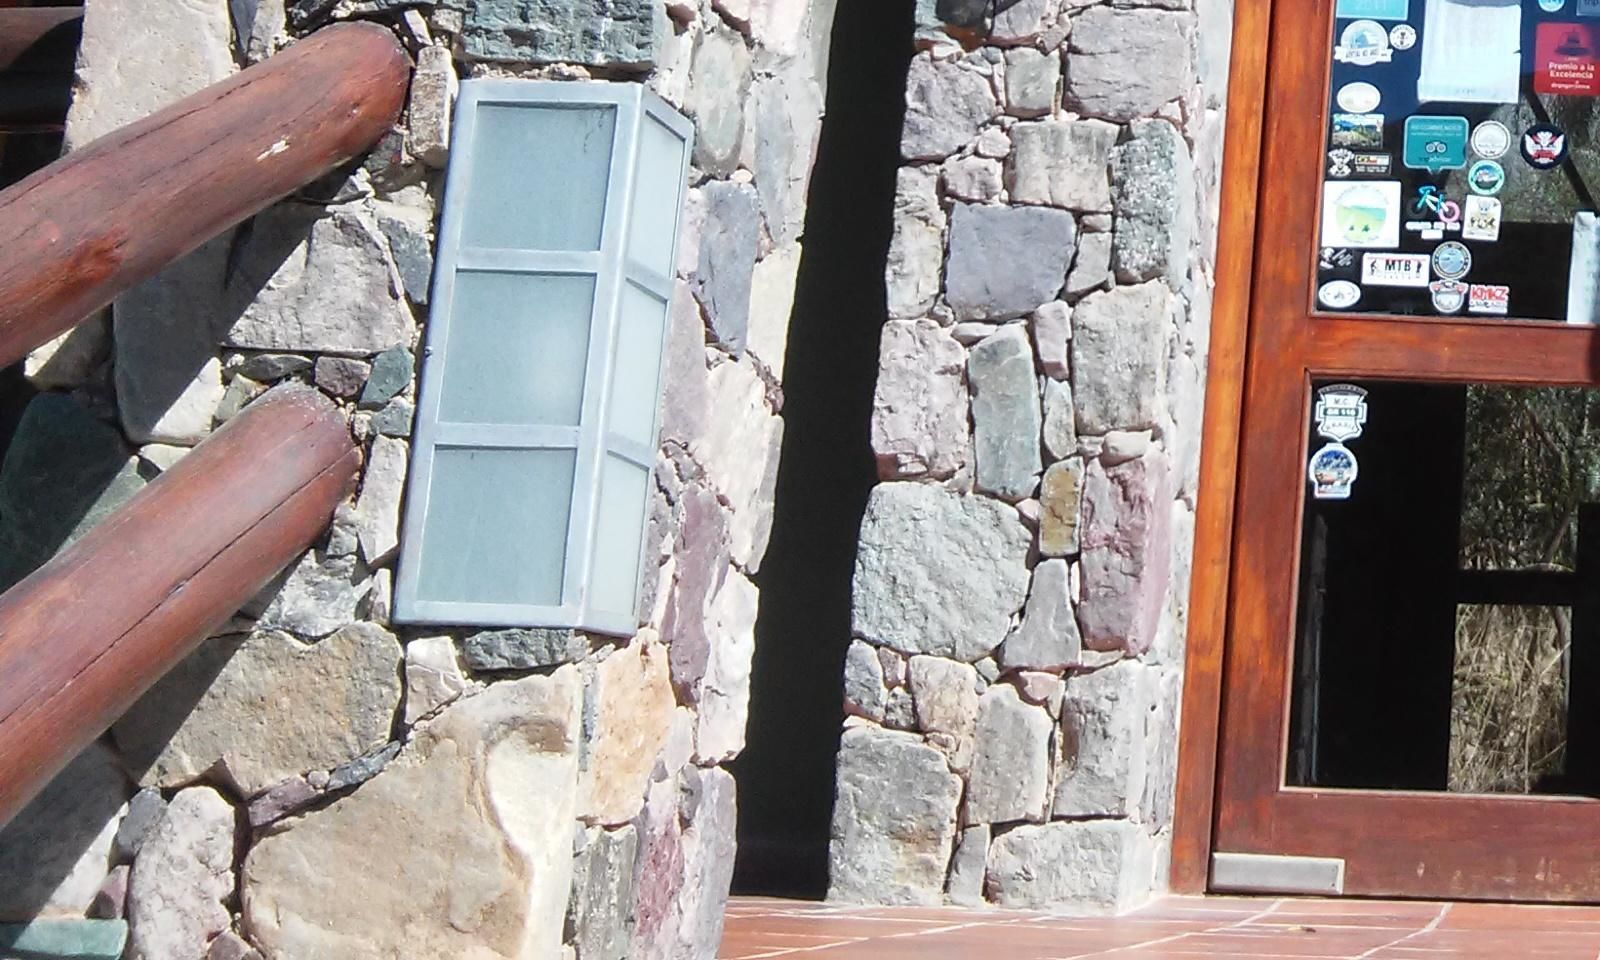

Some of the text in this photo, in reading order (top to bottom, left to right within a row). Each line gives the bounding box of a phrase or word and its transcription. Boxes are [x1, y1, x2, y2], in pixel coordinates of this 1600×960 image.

[1548, 61, 1578, 71] Premio
[1549, 70, 1594, 80] Excelencia
[1384, 259, 1411, 272] MTB
